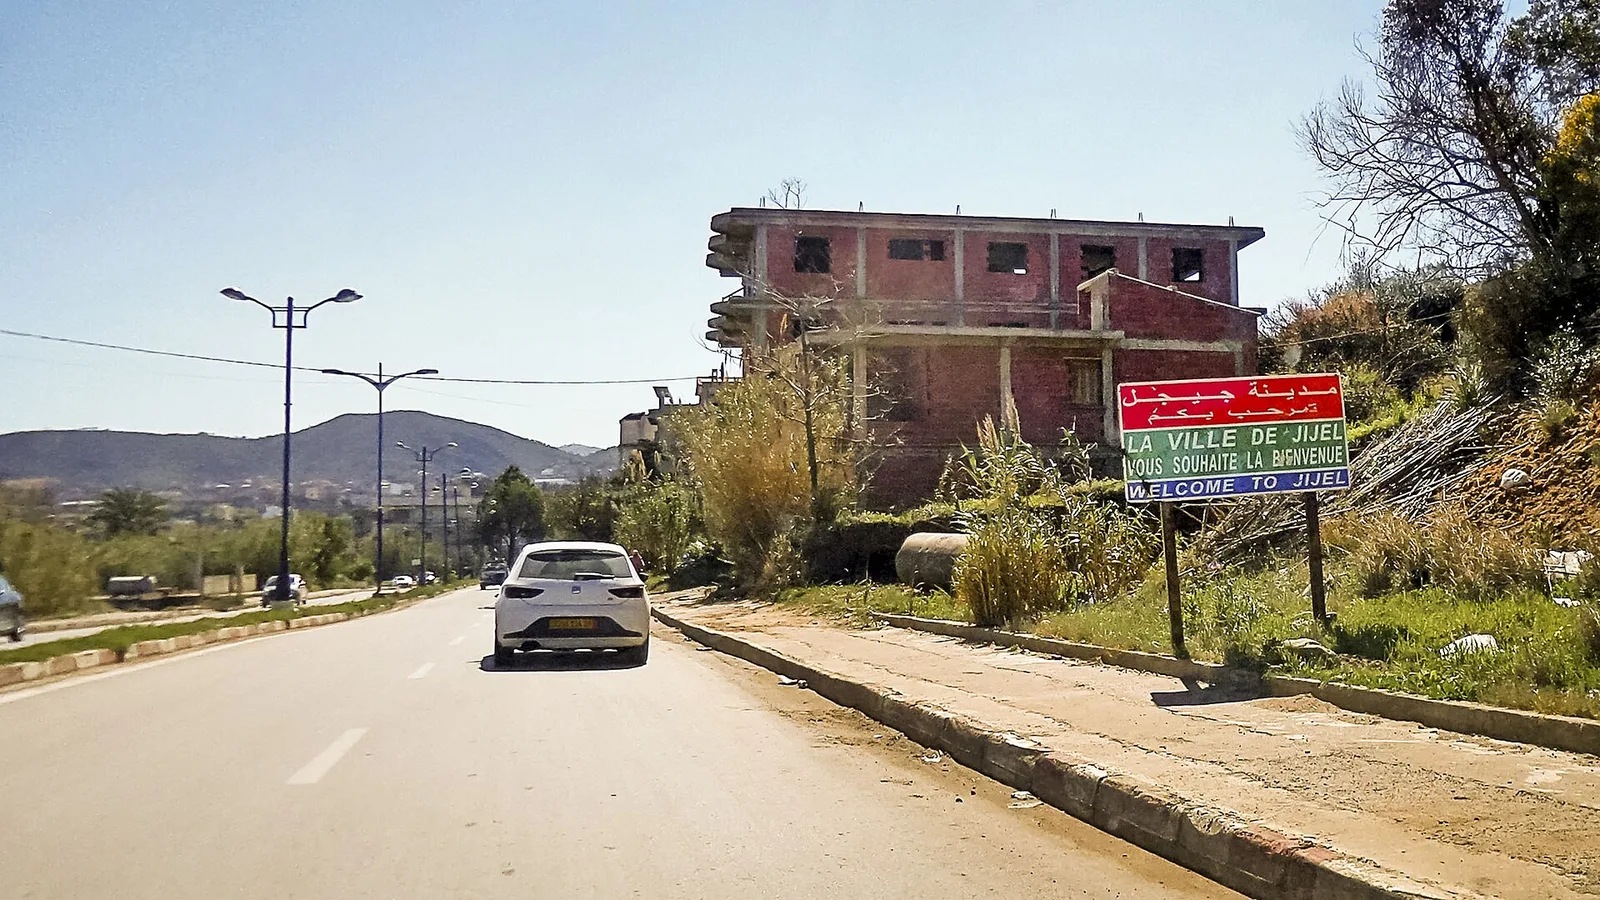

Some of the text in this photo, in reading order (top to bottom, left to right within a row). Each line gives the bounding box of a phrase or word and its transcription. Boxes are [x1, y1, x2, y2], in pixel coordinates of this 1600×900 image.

[1122, 381, 1338, 407] مدينة جيجل
[1127, 422, 1343, 454] LA VILLE DE JIJEL
[1127, 445, 1343, 477] VOUS SOUHAITE LA BIENVENUE
[1129, 470, 1346, 499] WELCOME TO JIJEL
